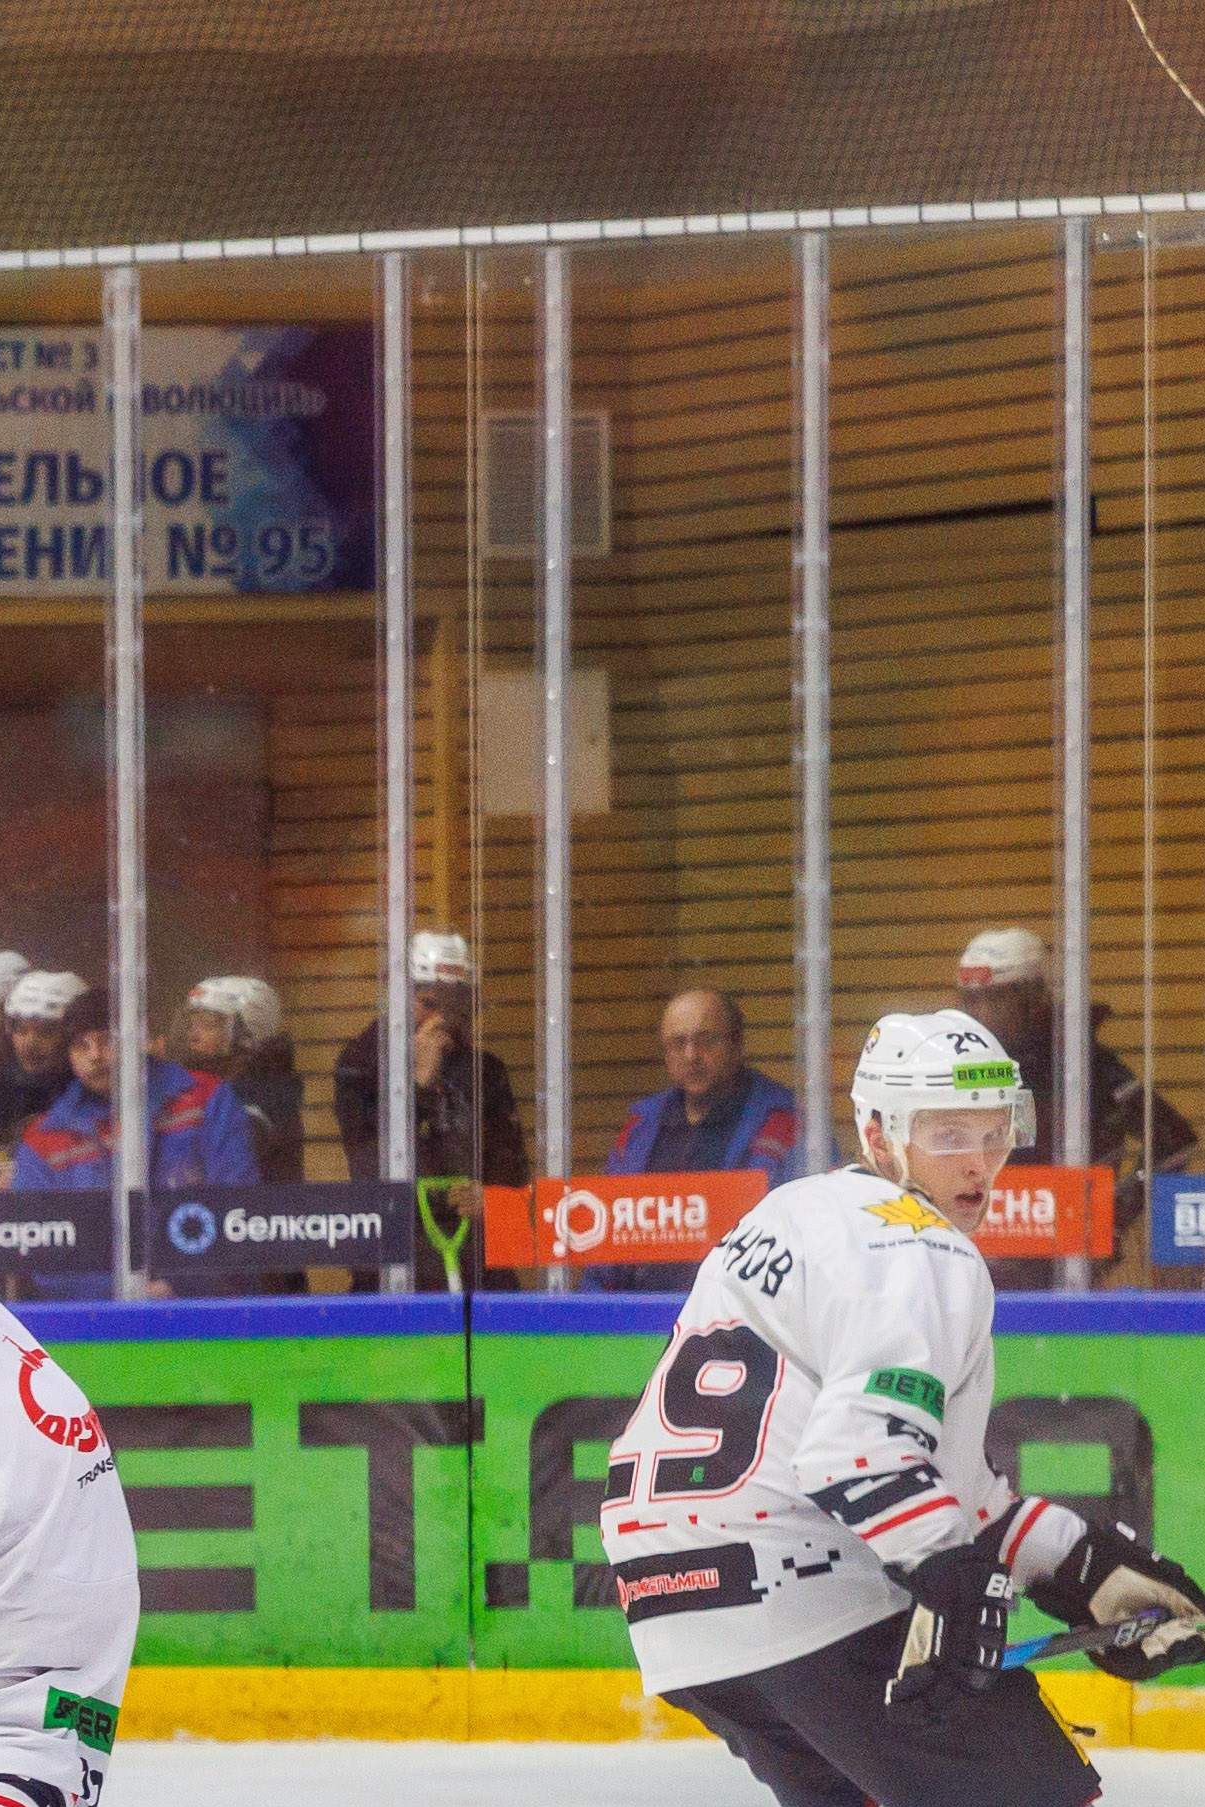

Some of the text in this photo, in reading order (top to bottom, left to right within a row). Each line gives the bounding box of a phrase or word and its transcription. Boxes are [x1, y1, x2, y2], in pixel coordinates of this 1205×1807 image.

[255, 520, 337, 584] 95
[946, 1031, 989, 1055] 29
[717, 1223, 794, 1298] НОВ
